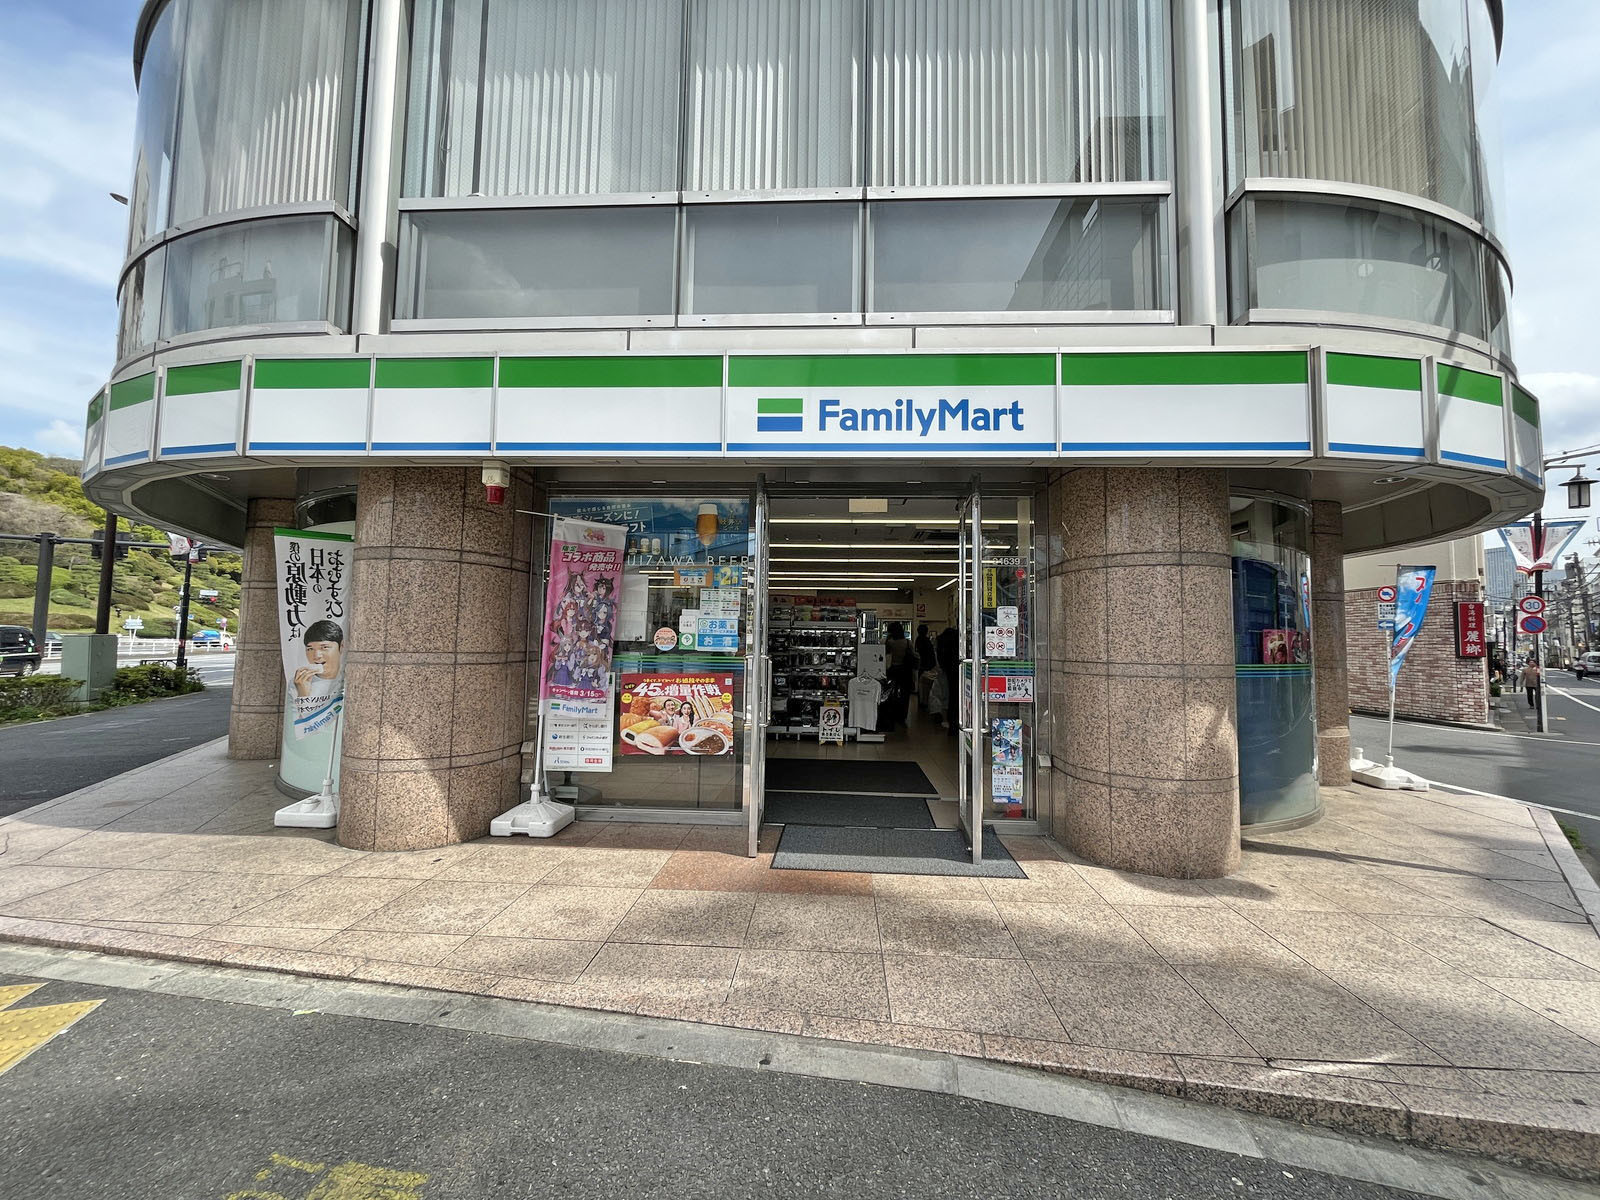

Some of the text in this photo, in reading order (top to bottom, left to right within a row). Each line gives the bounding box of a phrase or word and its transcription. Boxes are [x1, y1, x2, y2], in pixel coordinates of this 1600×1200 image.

[818, 399, 1025, 437] FamilyMart
[562, 551, 616, 562] コラボ商品
[707, 555, 748, 566] BEER
[588, 563, 621, 571] 発売中!!
[1525, 601, 1540, 610] 30
[1467, 603, 1476, 629] 台湾料理
[632, 682, 722, 697] 45%増量作戦
[562, 704, 598, 714] FamilyMart
